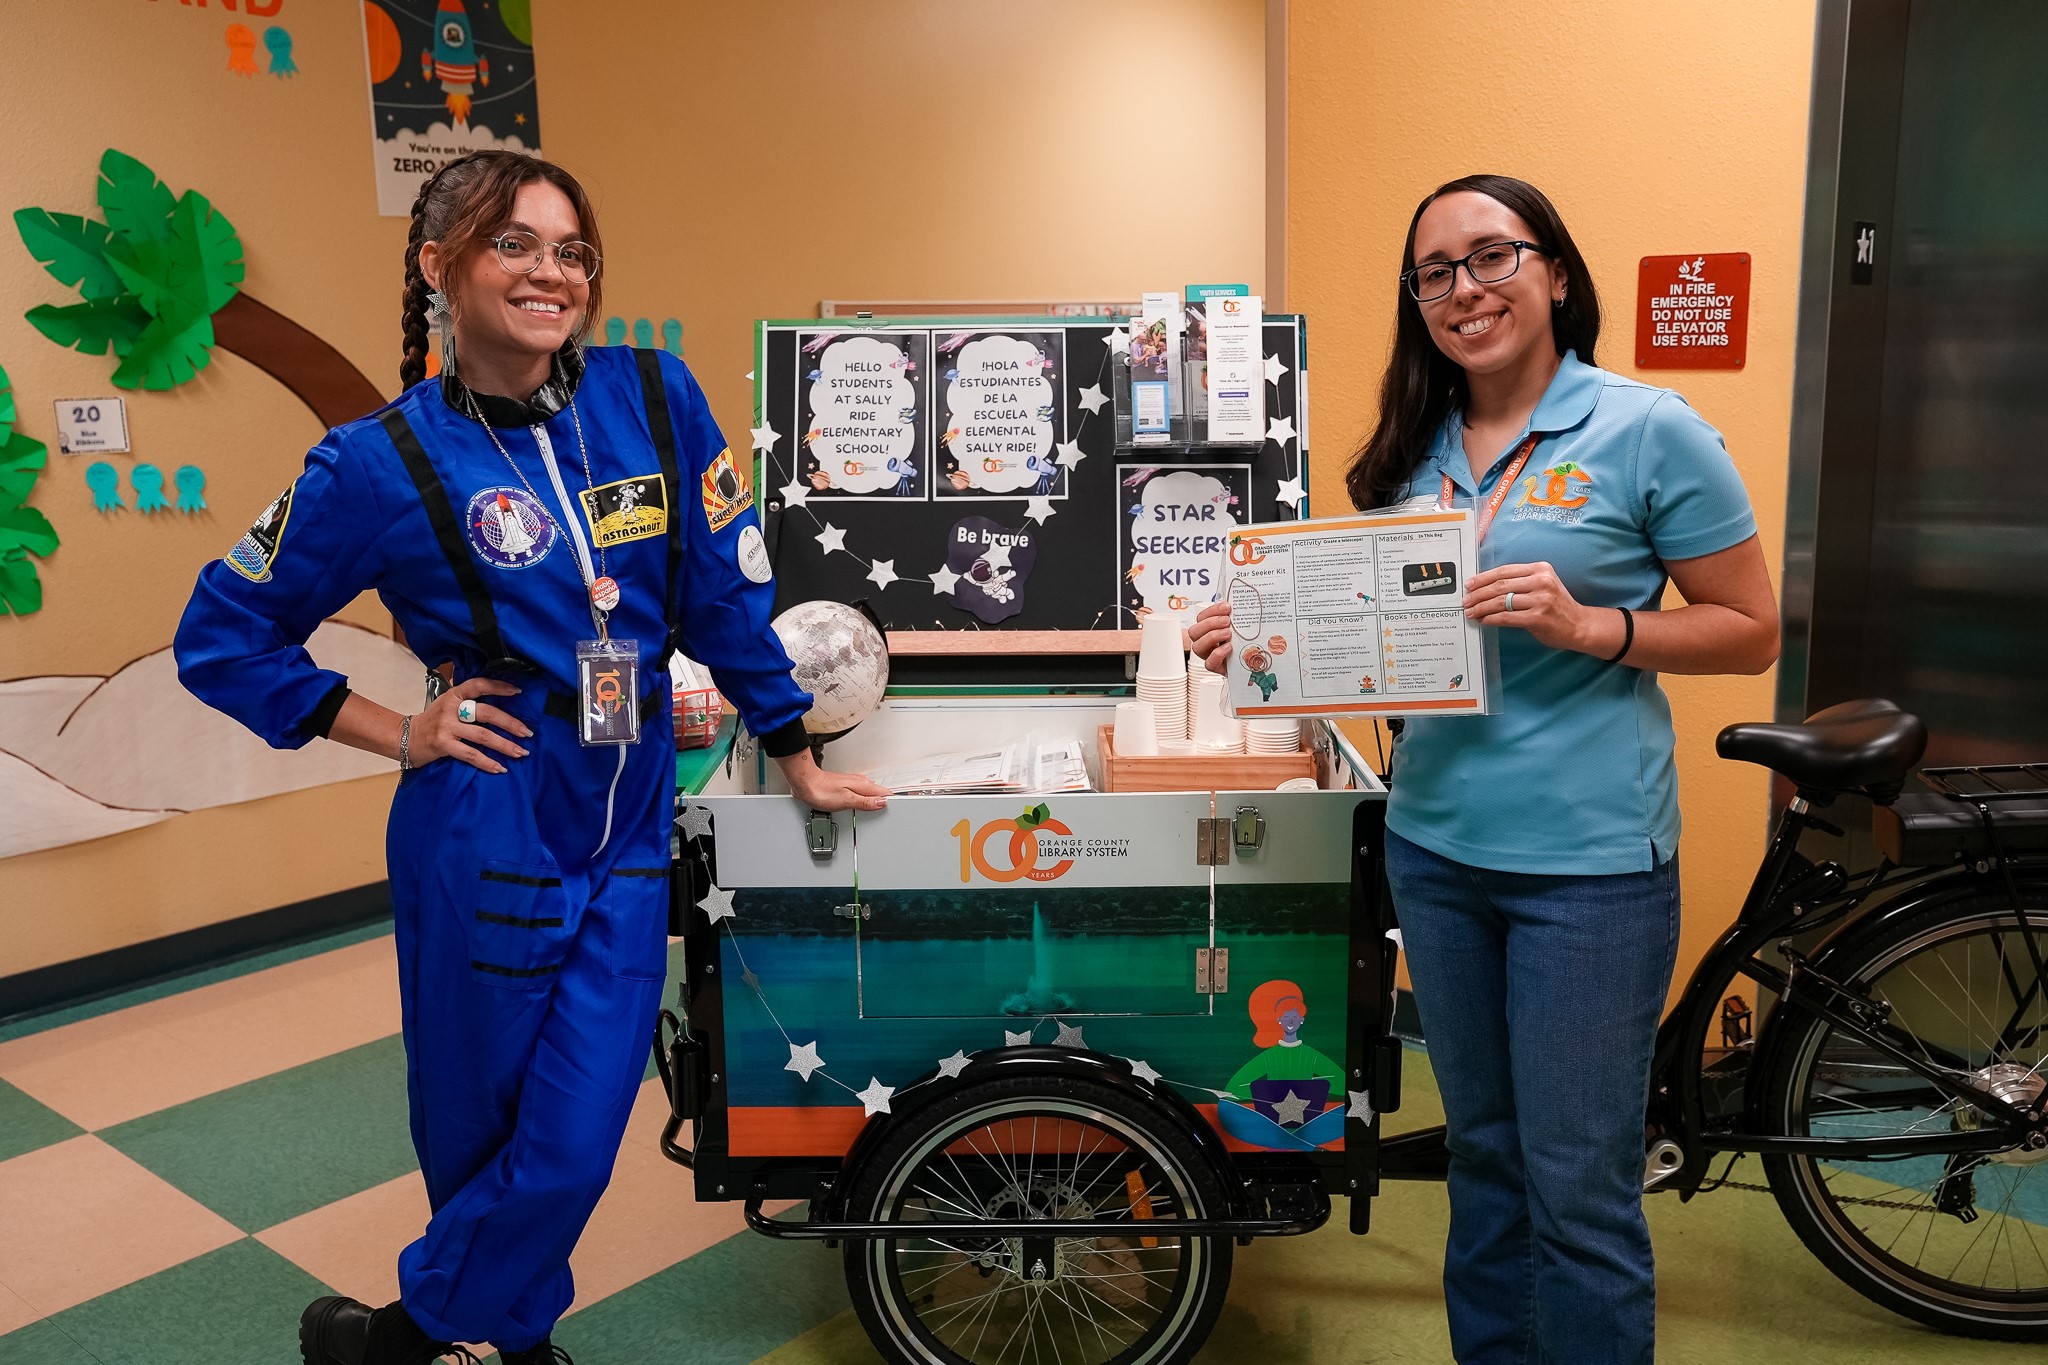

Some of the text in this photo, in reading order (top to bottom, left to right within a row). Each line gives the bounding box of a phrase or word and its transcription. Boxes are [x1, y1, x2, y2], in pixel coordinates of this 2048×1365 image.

[409, 143, 441, 154] You're
[393, 158, 436, 173] ZERO
[1669, 283, 1716, 295] IN FIRE
[1651, 295, 1734, 308] EMERGENCY
[1652, 308, 1732, 321] DO NOT USE
[1656, 321, 1726, 334] ELEVATOR
[1652, 334, 1729, 346] USE STAIRS
[845, 362, 882, 372] HELLO
[982, 361, 1019, 371] !HOLA
[831, 379, 893, 388] STUDENTS
[960, 377, 1041, 388] ESTUDIANTES
[834, 395, 892, 405] AT SALLY
[984, 393, 1017, 403] DE LA
[72, 405, 100, 423] 20
[849, 411, 876, 421] RIDE
[974, 409, 1028, 420] ESCUELA
[822, 427, 903, 438] ELEMENTARY
[965, 426, 1037, 437] ELEMENTAL
[835, 443, 889, 454] SCHOOL!
[966, 442, 1037, 453] SALLY RIDE!
[1489, 479, 1510, 507] GROW.
[711, 503, 735, 525] SUPER
[1153, 504, 1216, 521] STAR
[1513, 506, 1584, 517] ORANGE COUNTY
[1511, 511, 1581, 525] LIBRARY SYSTEM
[602, 522, 661, 542] ASTRONAUT
[957, 526, 1029, 548] Be brave
[1295, 539, 1321, 547] Activity
[1379, 534, 1414, 542] Materials
[244, 532, 270, 560] SHUTTLE
[1160, 568, 1210, 586] KITS
[594, 579, 612, 592] Hablo
[1339, 616, 1364, 624] Know?
[1420, 611, 1460, 619] Checkout!
[1039, 839, 1083, 847] ORANGE
[1039, 847, 1128, 857] LIBRARY SYSTEM
